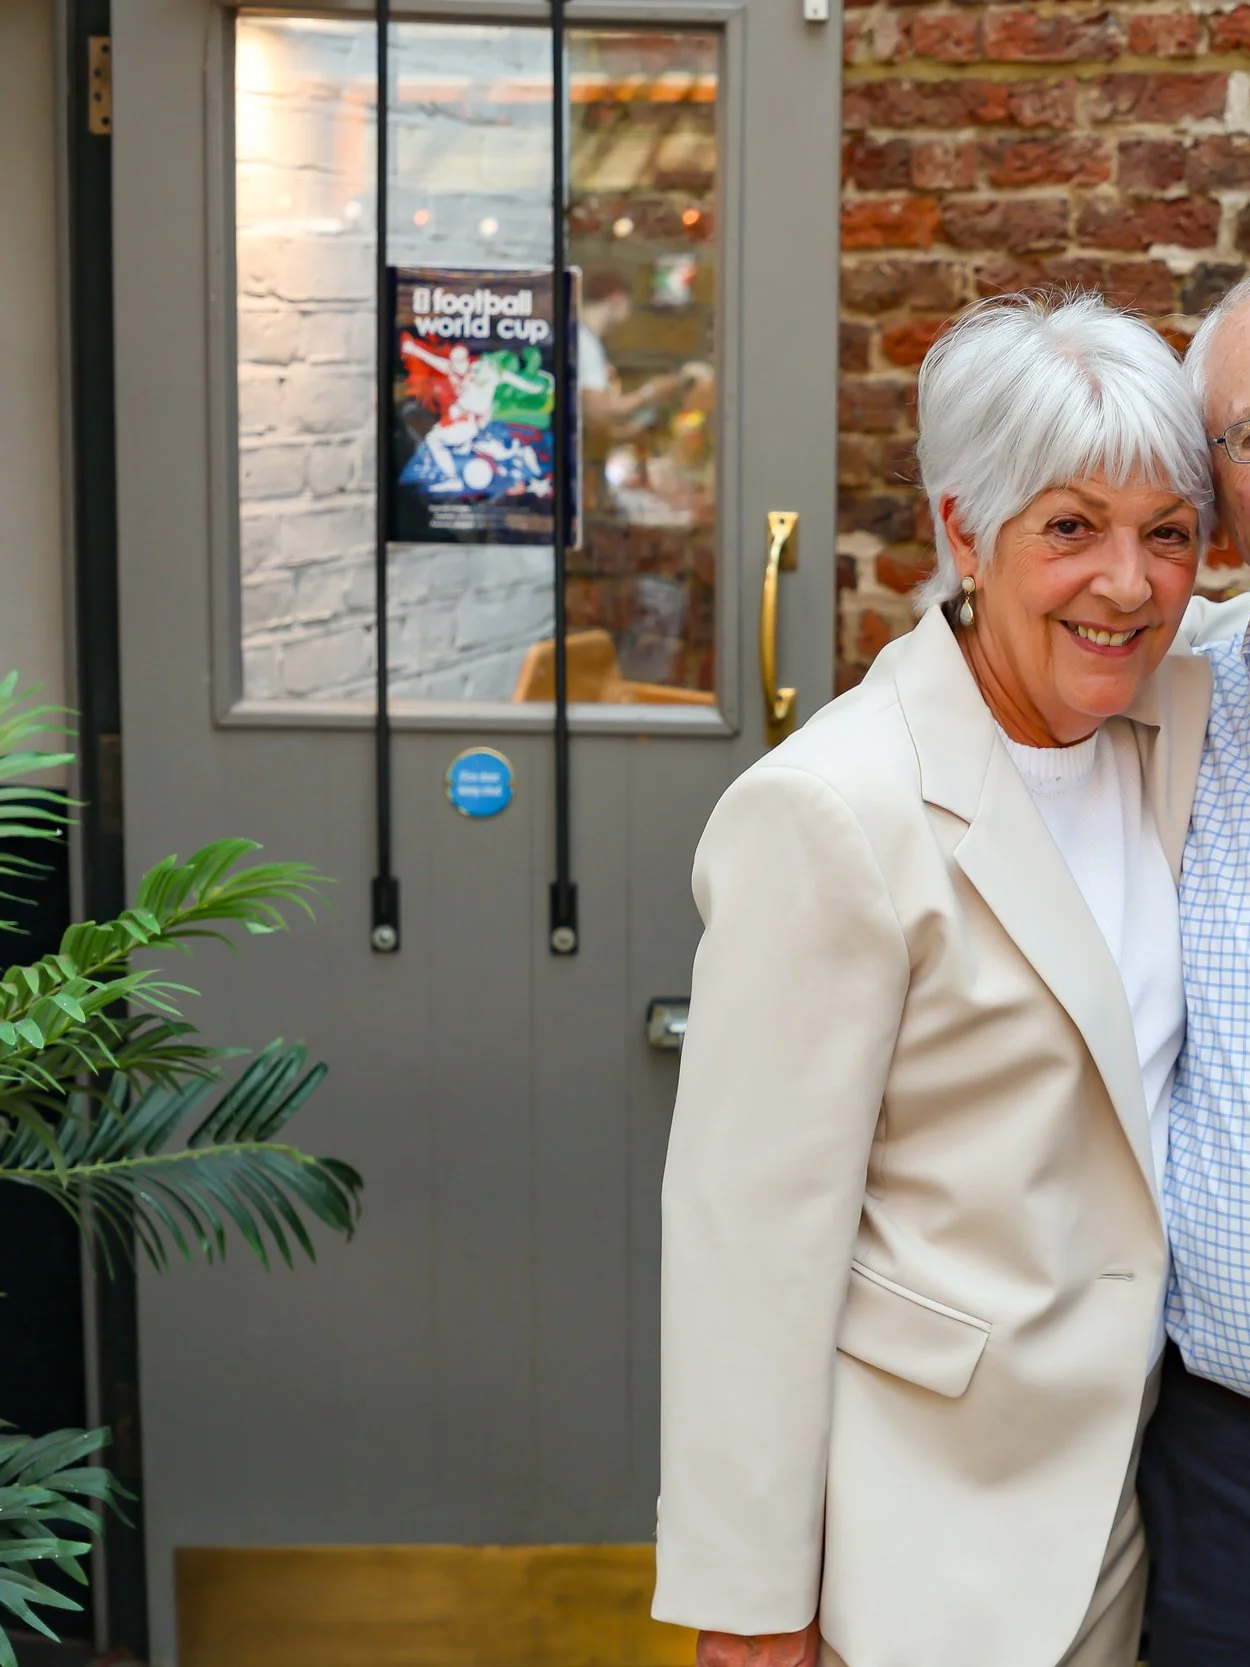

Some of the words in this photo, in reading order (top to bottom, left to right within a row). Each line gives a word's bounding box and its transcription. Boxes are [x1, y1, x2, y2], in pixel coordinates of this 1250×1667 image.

[432, 287, 533, 316] football
[414, 313, 490, 339] world
[496, 318, 550, 345] cup
